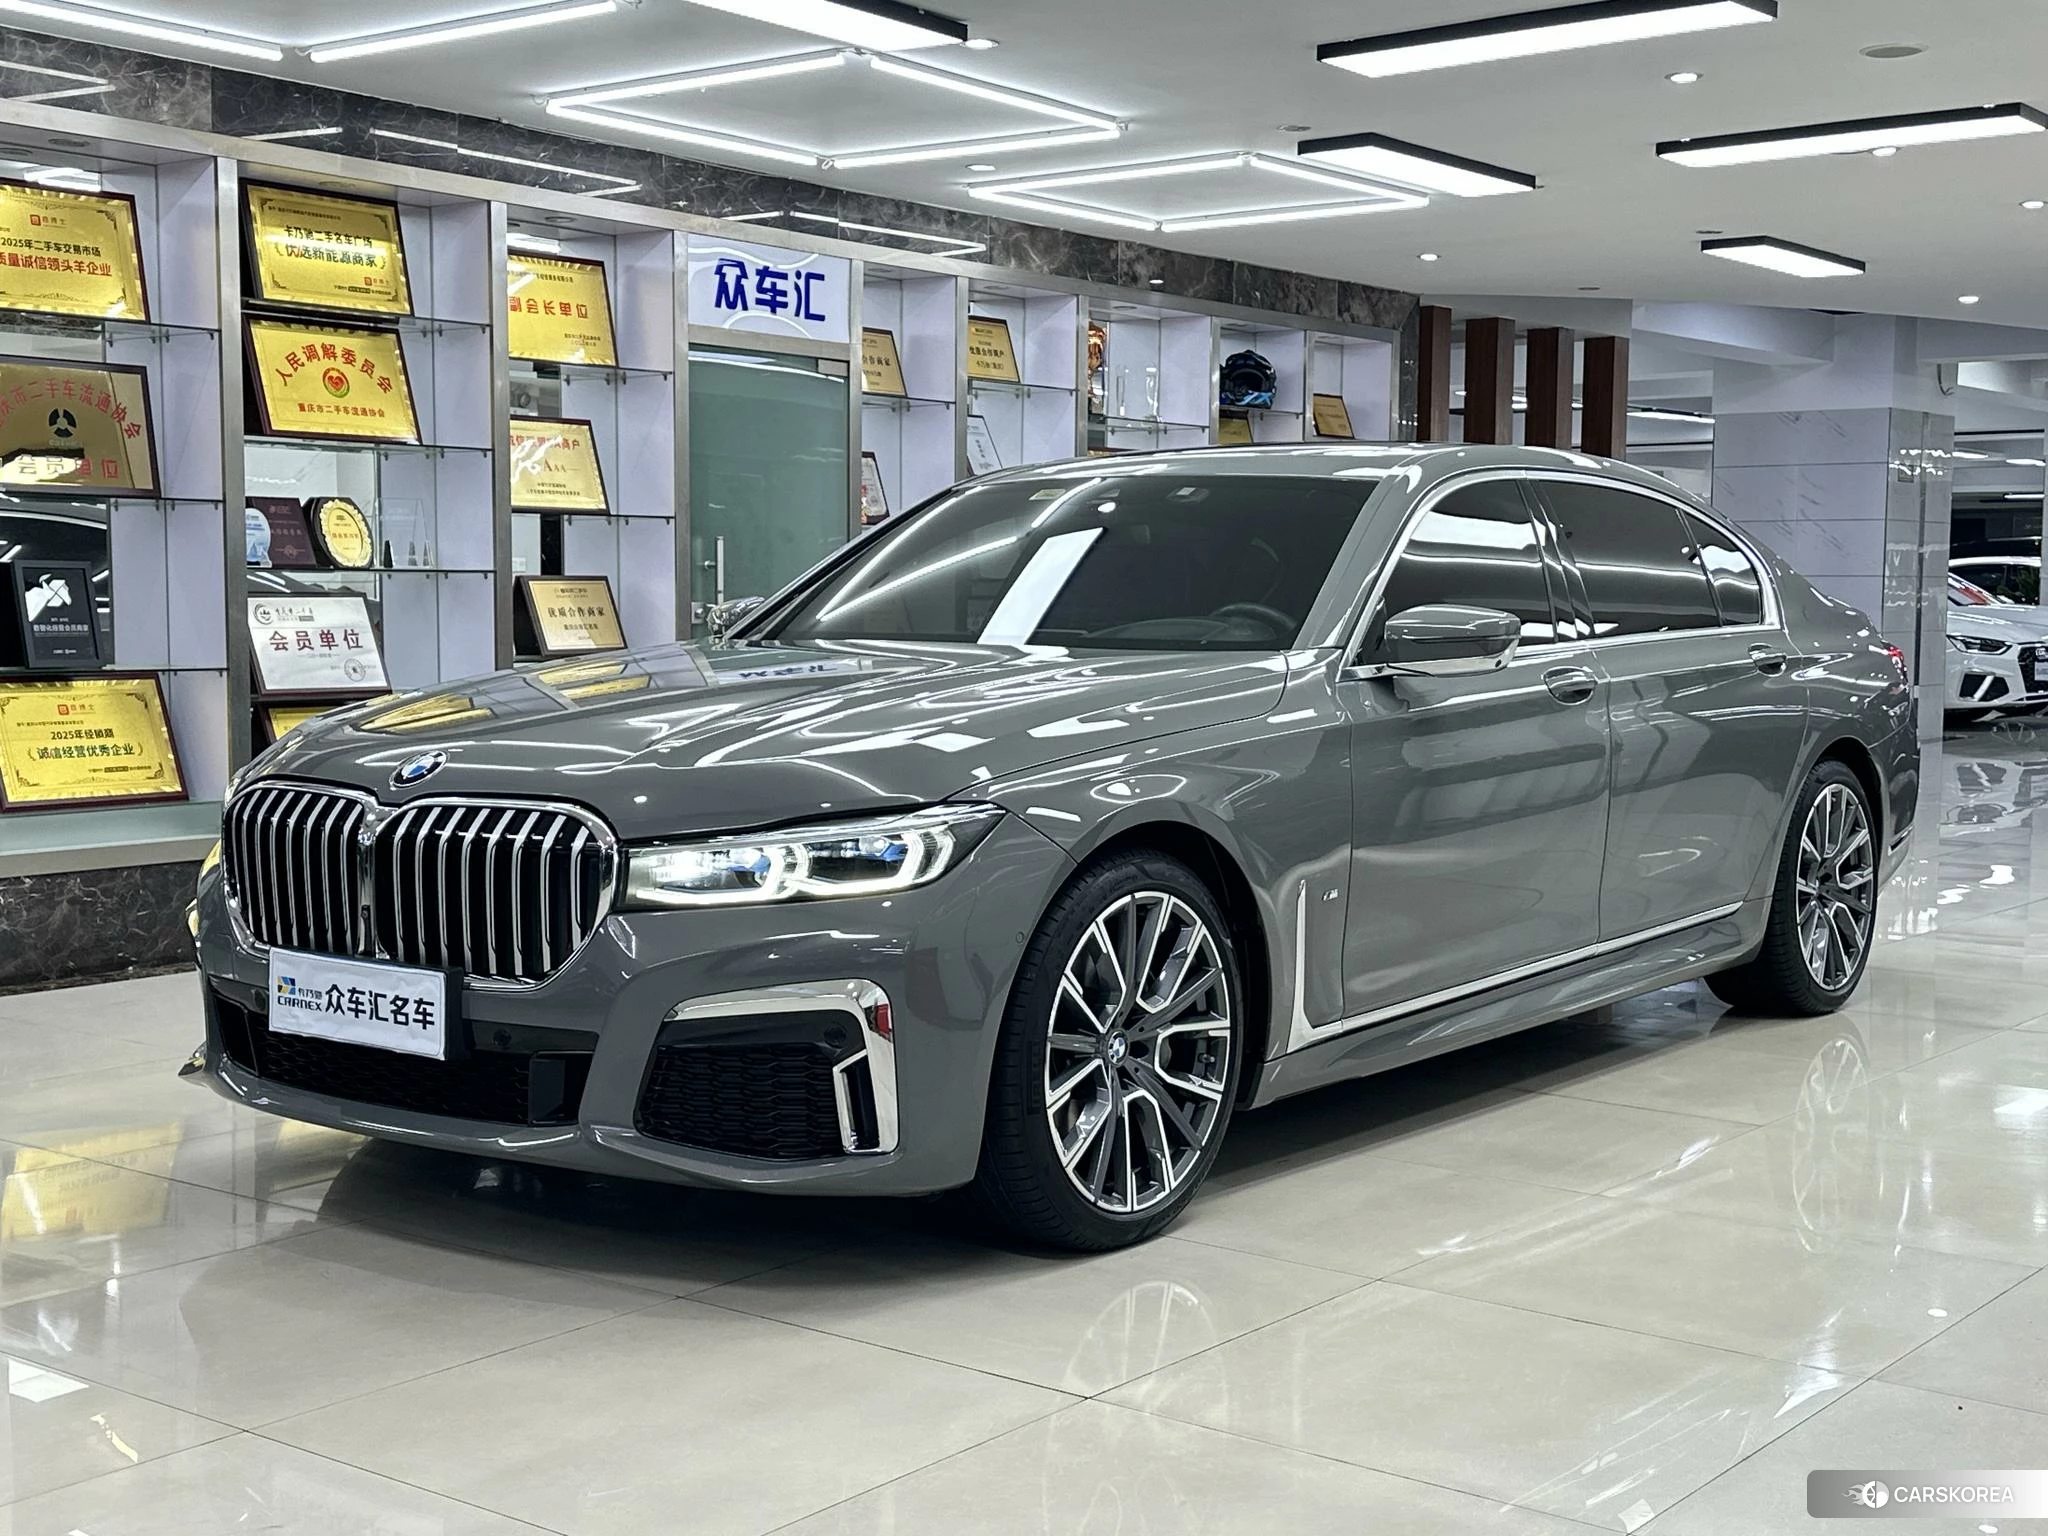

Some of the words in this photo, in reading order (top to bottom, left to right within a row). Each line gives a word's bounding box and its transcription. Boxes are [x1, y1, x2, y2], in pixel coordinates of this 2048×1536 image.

[1, 236, 102, 257] 2025年二手车交易市场
[714, 258, 826, 322] 众车汇
[508, 296, 588, 319] 副会长单位
[275, 342, 392, 394] 人民调解委员会
[0, 378, 142, 439] 庆市二手车流通协会
[298, 403, 385, 418] 重庆市二手车流通协会
[269, 629, 364, 651] 会员单位
[36, 743, 135, 760] 诚信经营优秀企业
[325, 983, 435, 1030] 众车汇名车
